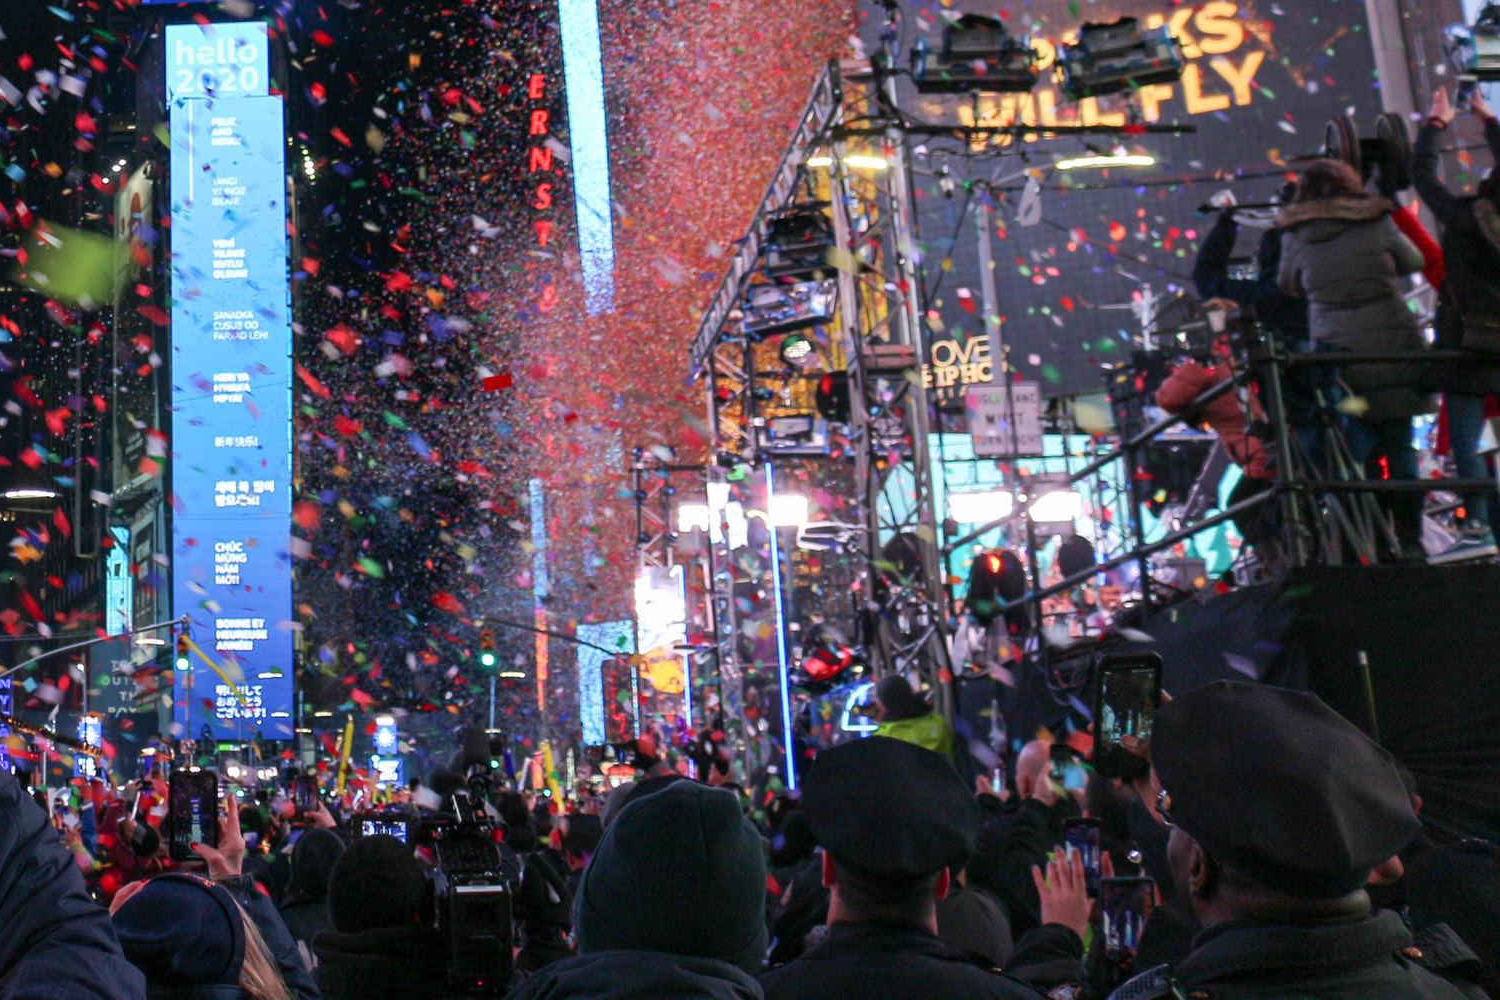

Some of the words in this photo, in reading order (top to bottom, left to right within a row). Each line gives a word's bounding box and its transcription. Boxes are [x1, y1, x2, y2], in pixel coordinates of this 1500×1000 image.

[175, 38, 259, 66] hello
[176, 67, 260, 94] 2020
[1139, 52, 1266, 123] FLY
[529, 73, 552, 247] ERNST
[931, 335, 992, 368] OVE
